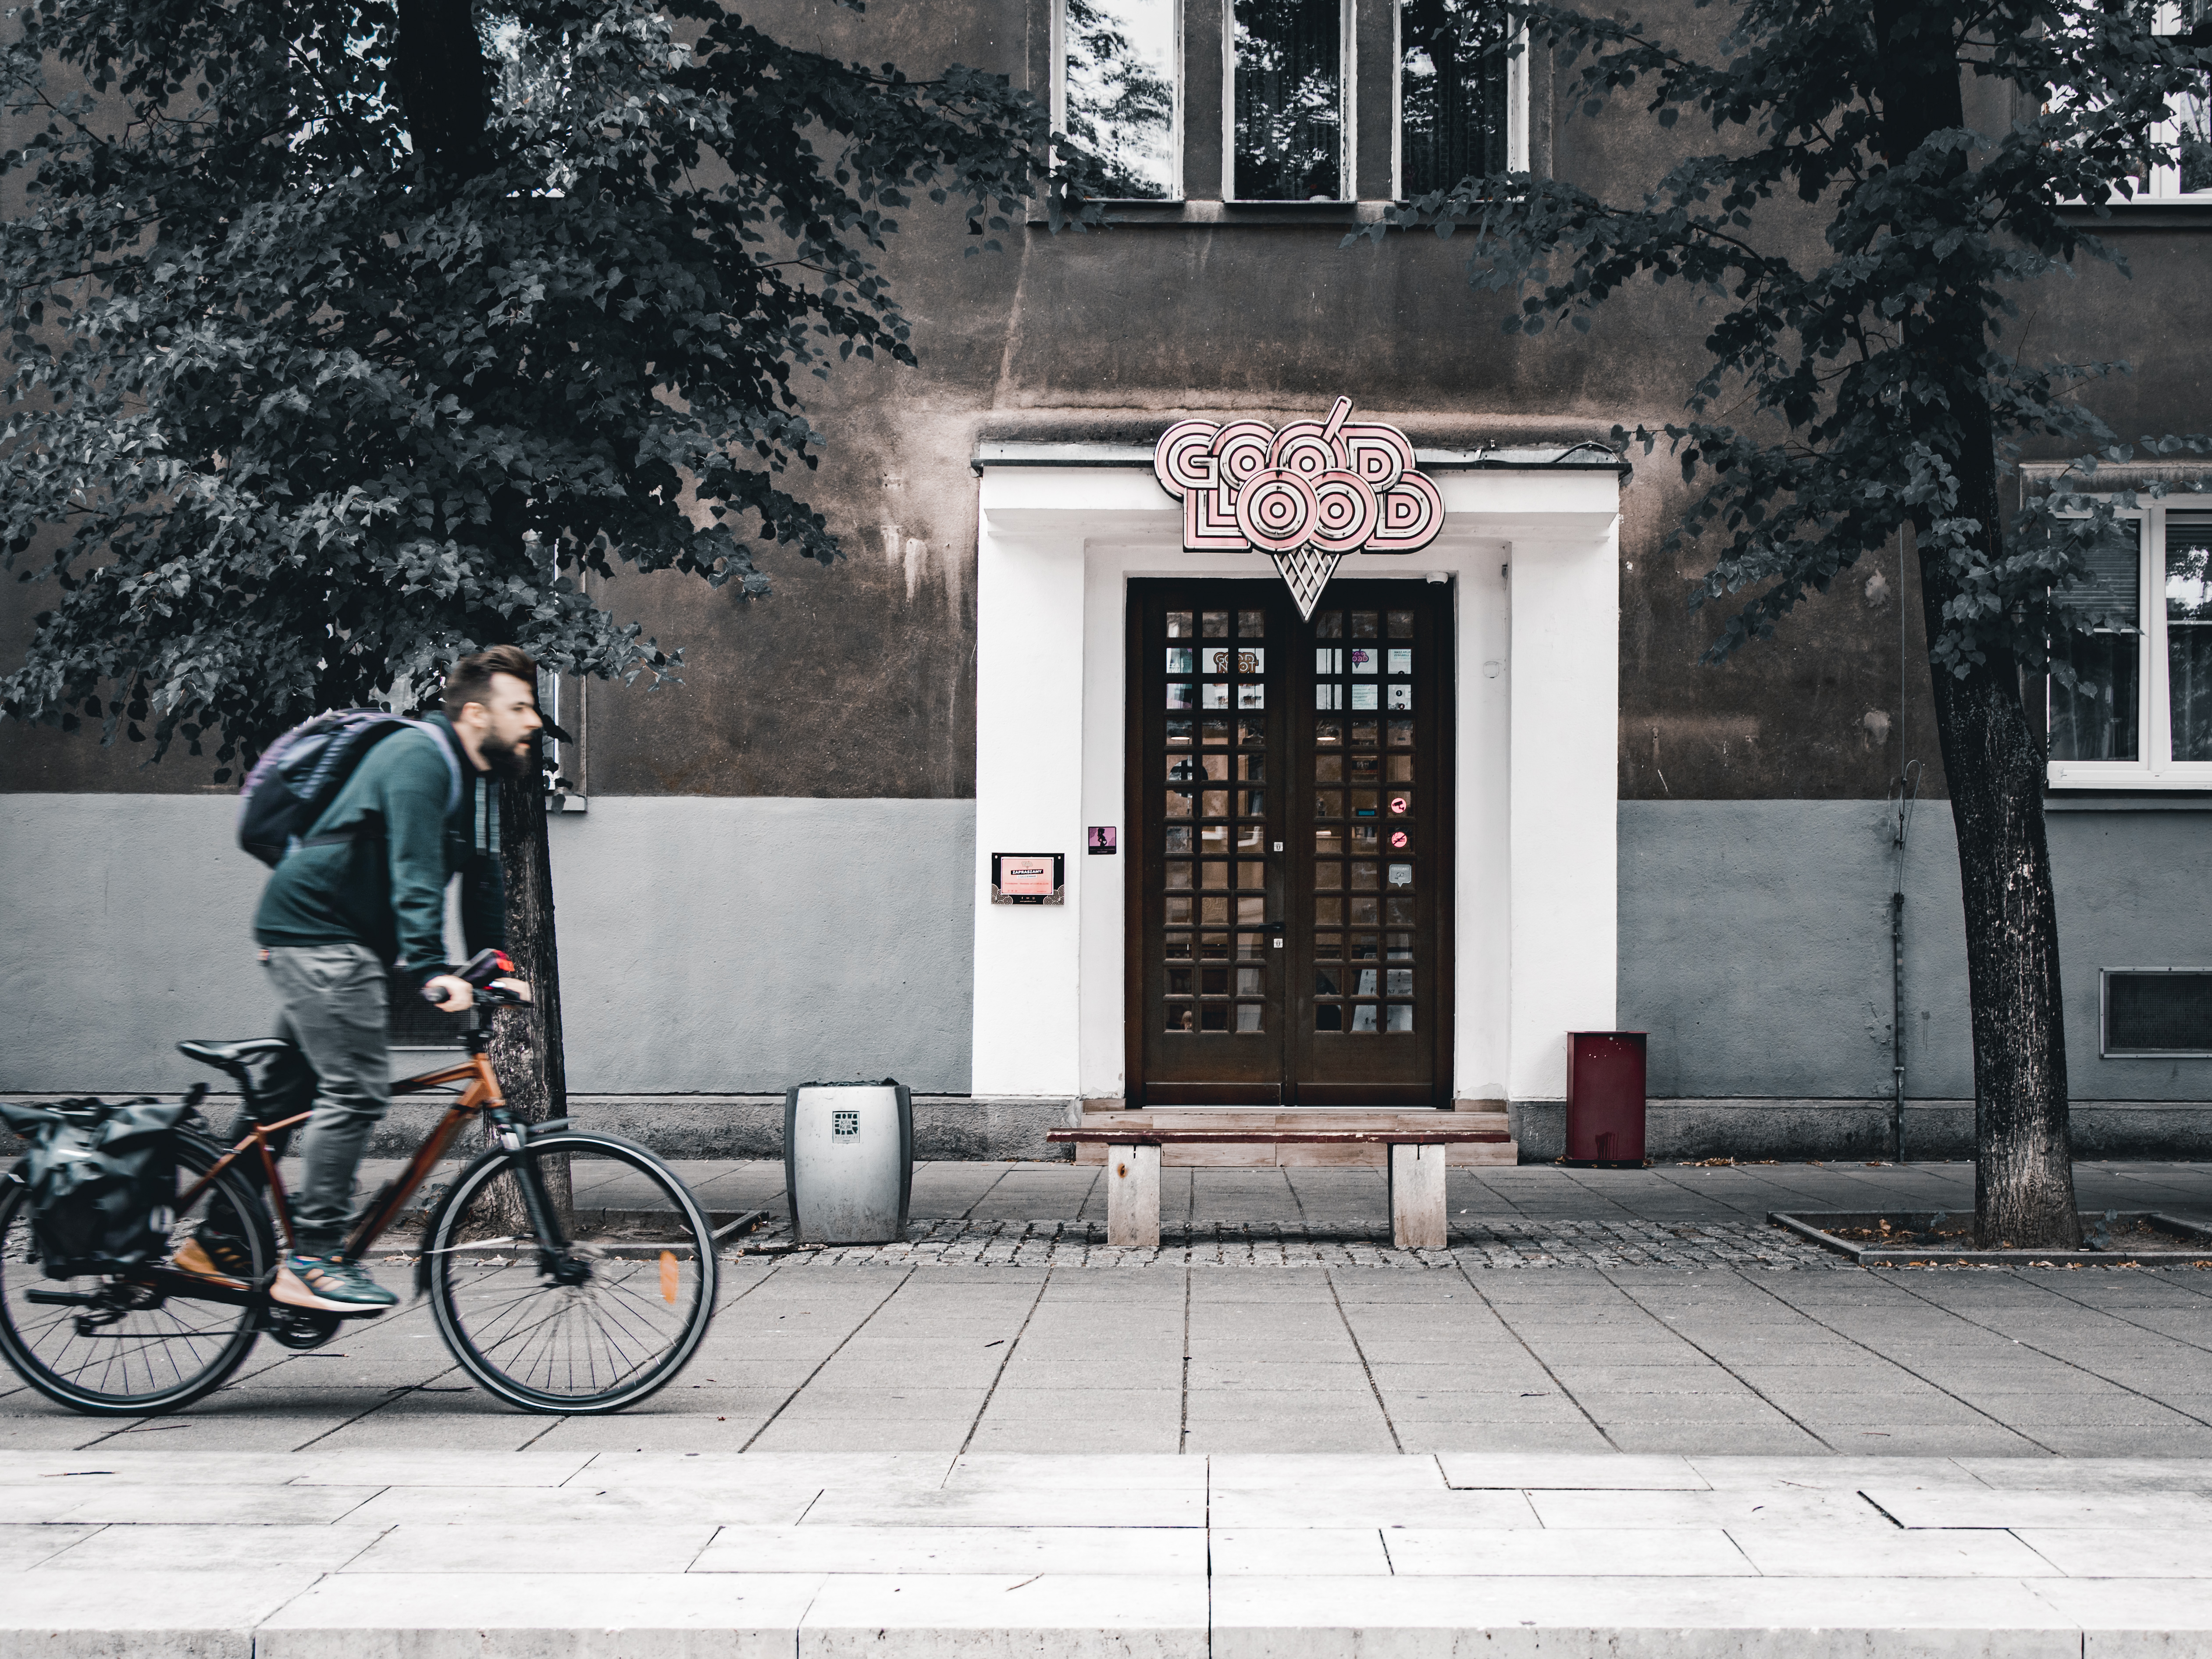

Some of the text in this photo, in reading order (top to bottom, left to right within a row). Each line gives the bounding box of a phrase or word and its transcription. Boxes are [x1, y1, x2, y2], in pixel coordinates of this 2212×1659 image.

[1154, 418, 1416, 500] GOOD
[1183, 467, 1446, 552] LOOD
[1217, 661, 1257, 673] NOT
